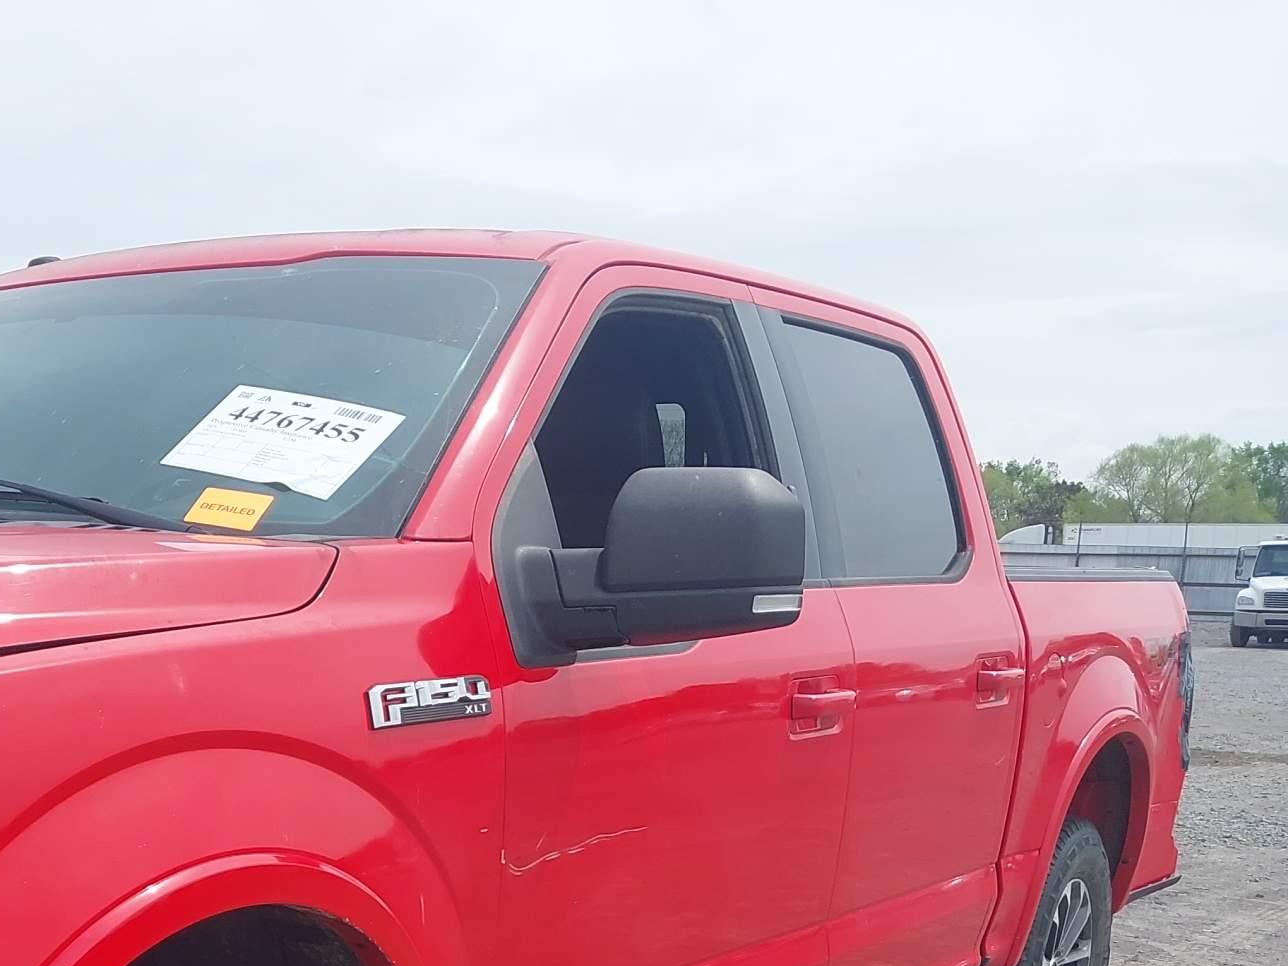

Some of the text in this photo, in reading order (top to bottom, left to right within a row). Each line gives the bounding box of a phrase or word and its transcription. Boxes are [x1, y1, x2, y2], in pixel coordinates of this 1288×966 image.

[228, 406, 368, 443] 44767455
[199, 501, 256, 517] DETAILED
[464, 703, 488, 714] XLT
